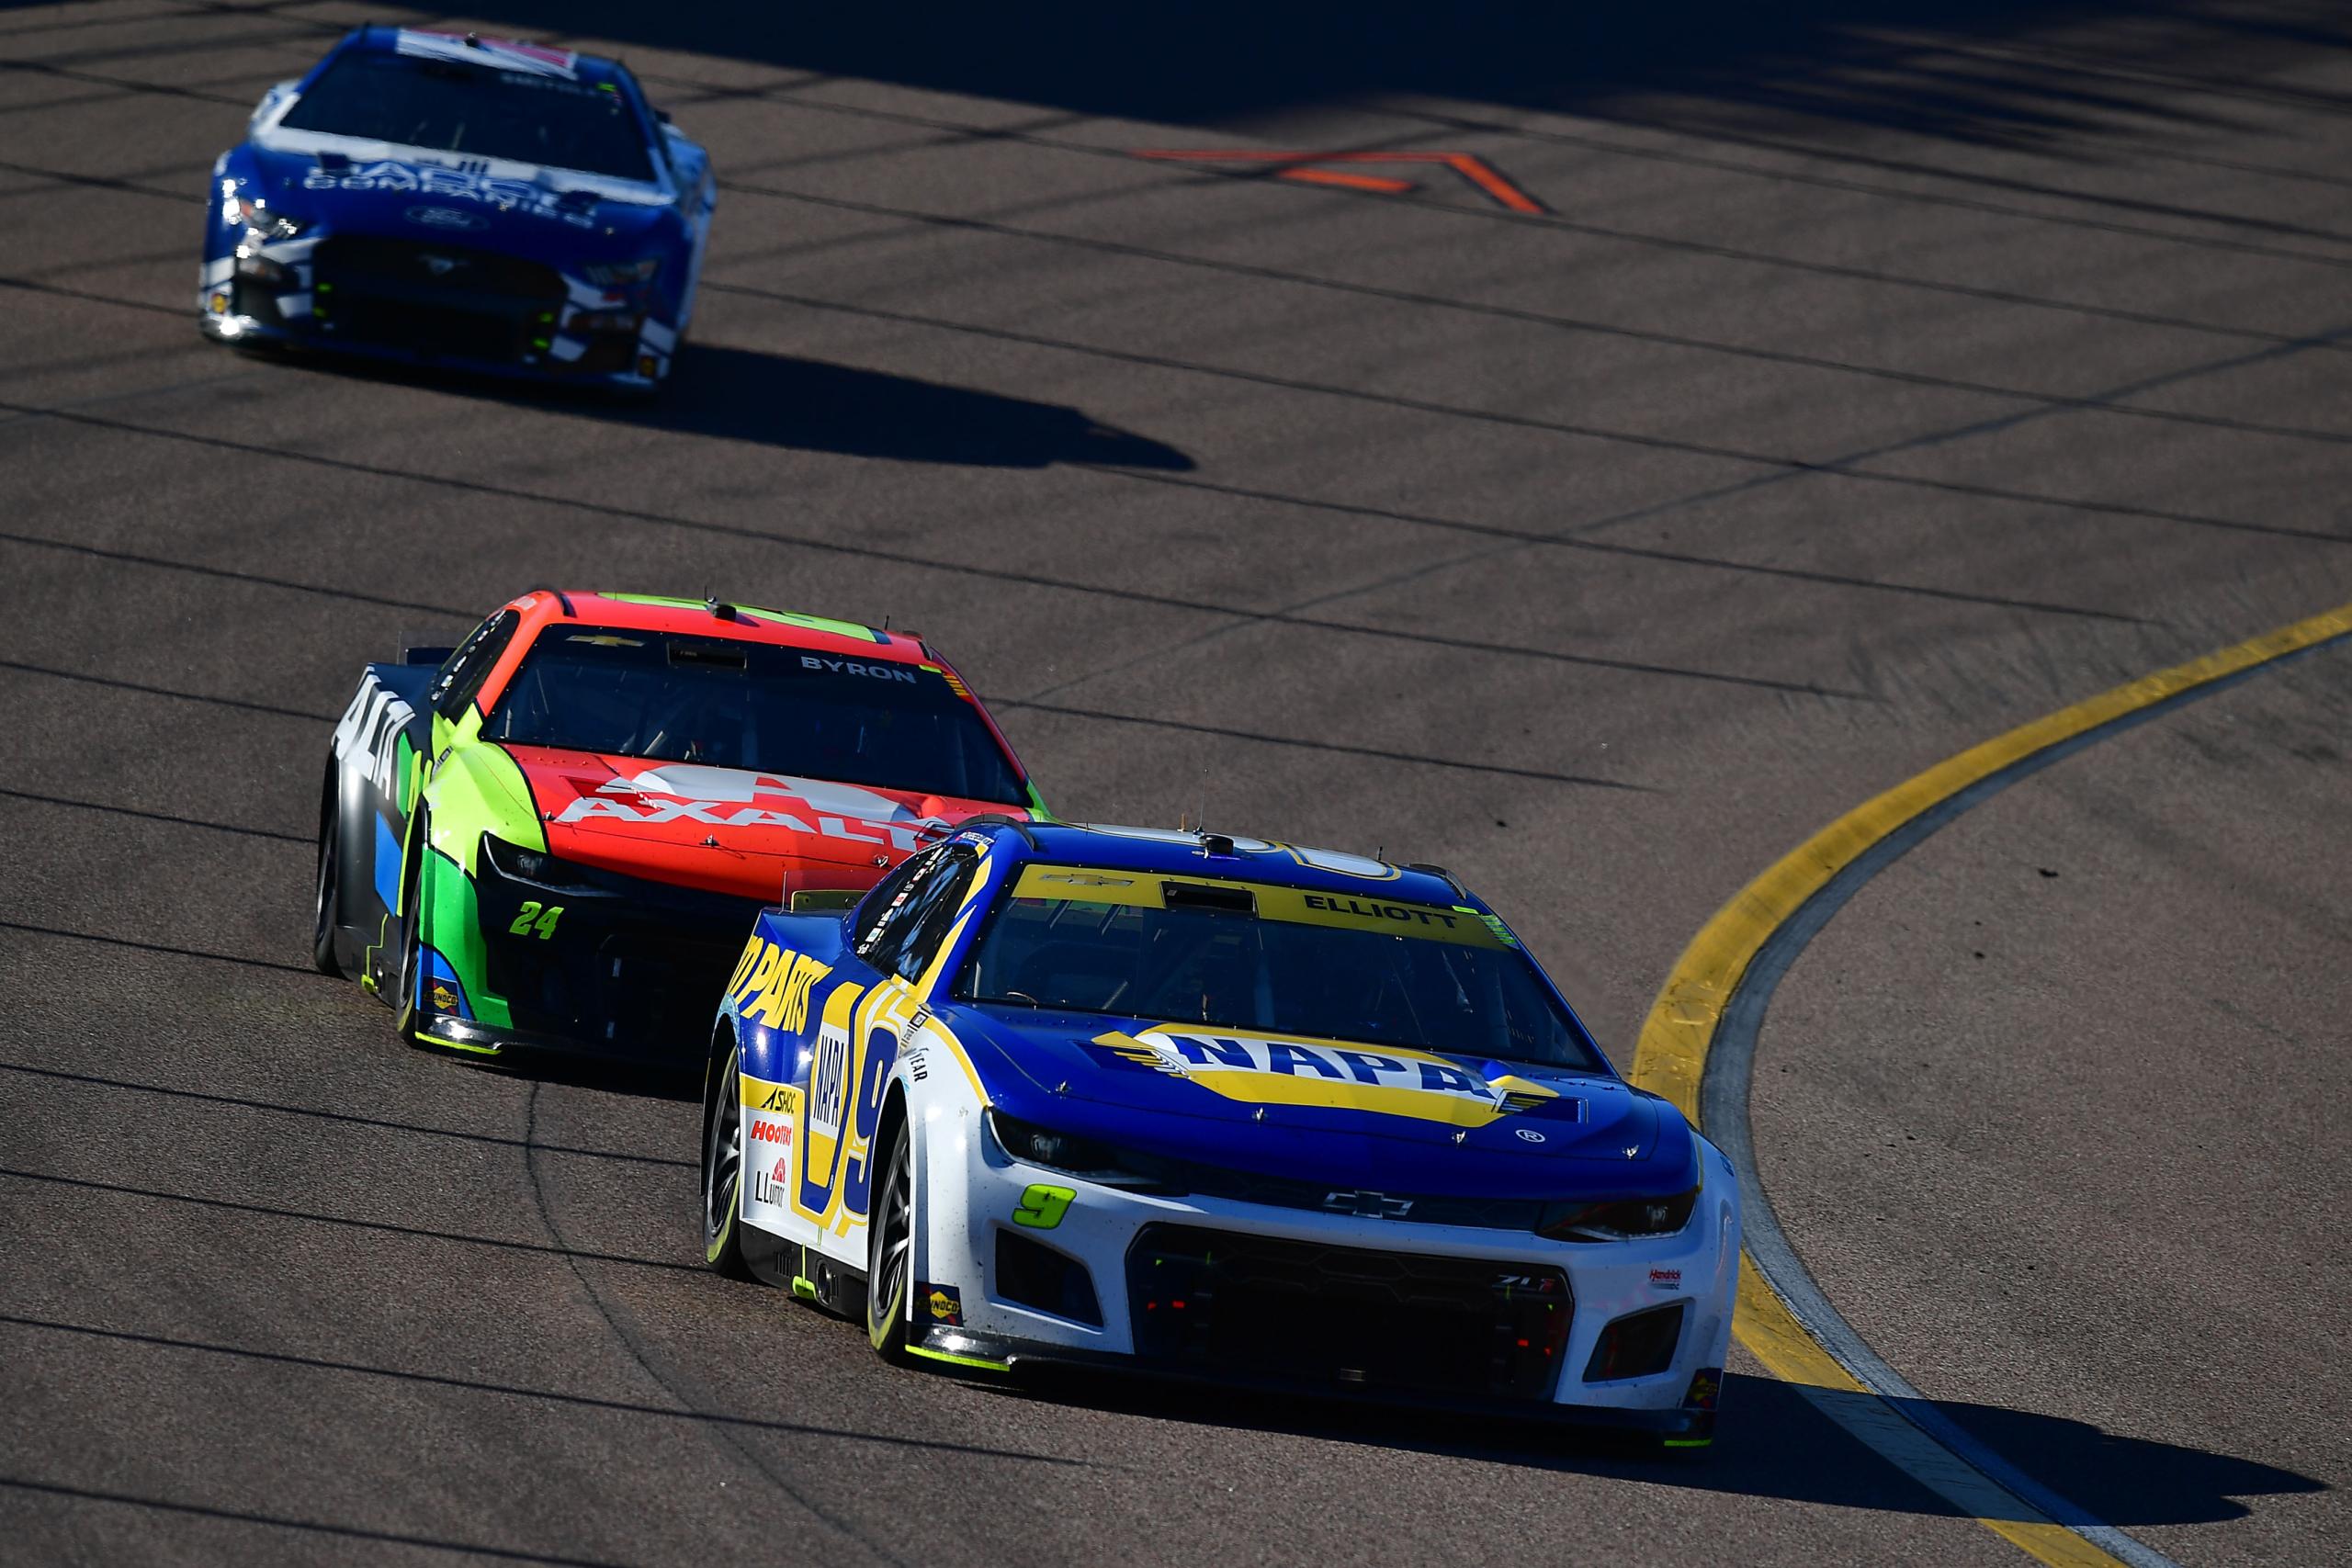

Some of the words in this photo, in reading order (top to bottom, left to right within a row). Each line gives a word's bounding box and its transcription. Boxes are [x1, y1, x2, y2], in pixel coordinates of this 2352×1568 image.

[800, 656, 917, 684] BYRON
[553, 796, 922, 852] AXALT
[508, 901, 565, 940] 24
[1304, 894, 1458, 929] ELLIOTT
[813, 1033, 844, 1128] NAPA
[1168, 1035, 1498, 1100] NAPA
[751, 1120, 792, 1147] HOOTERS
[1012, 1183, 1078, 1230] 9
